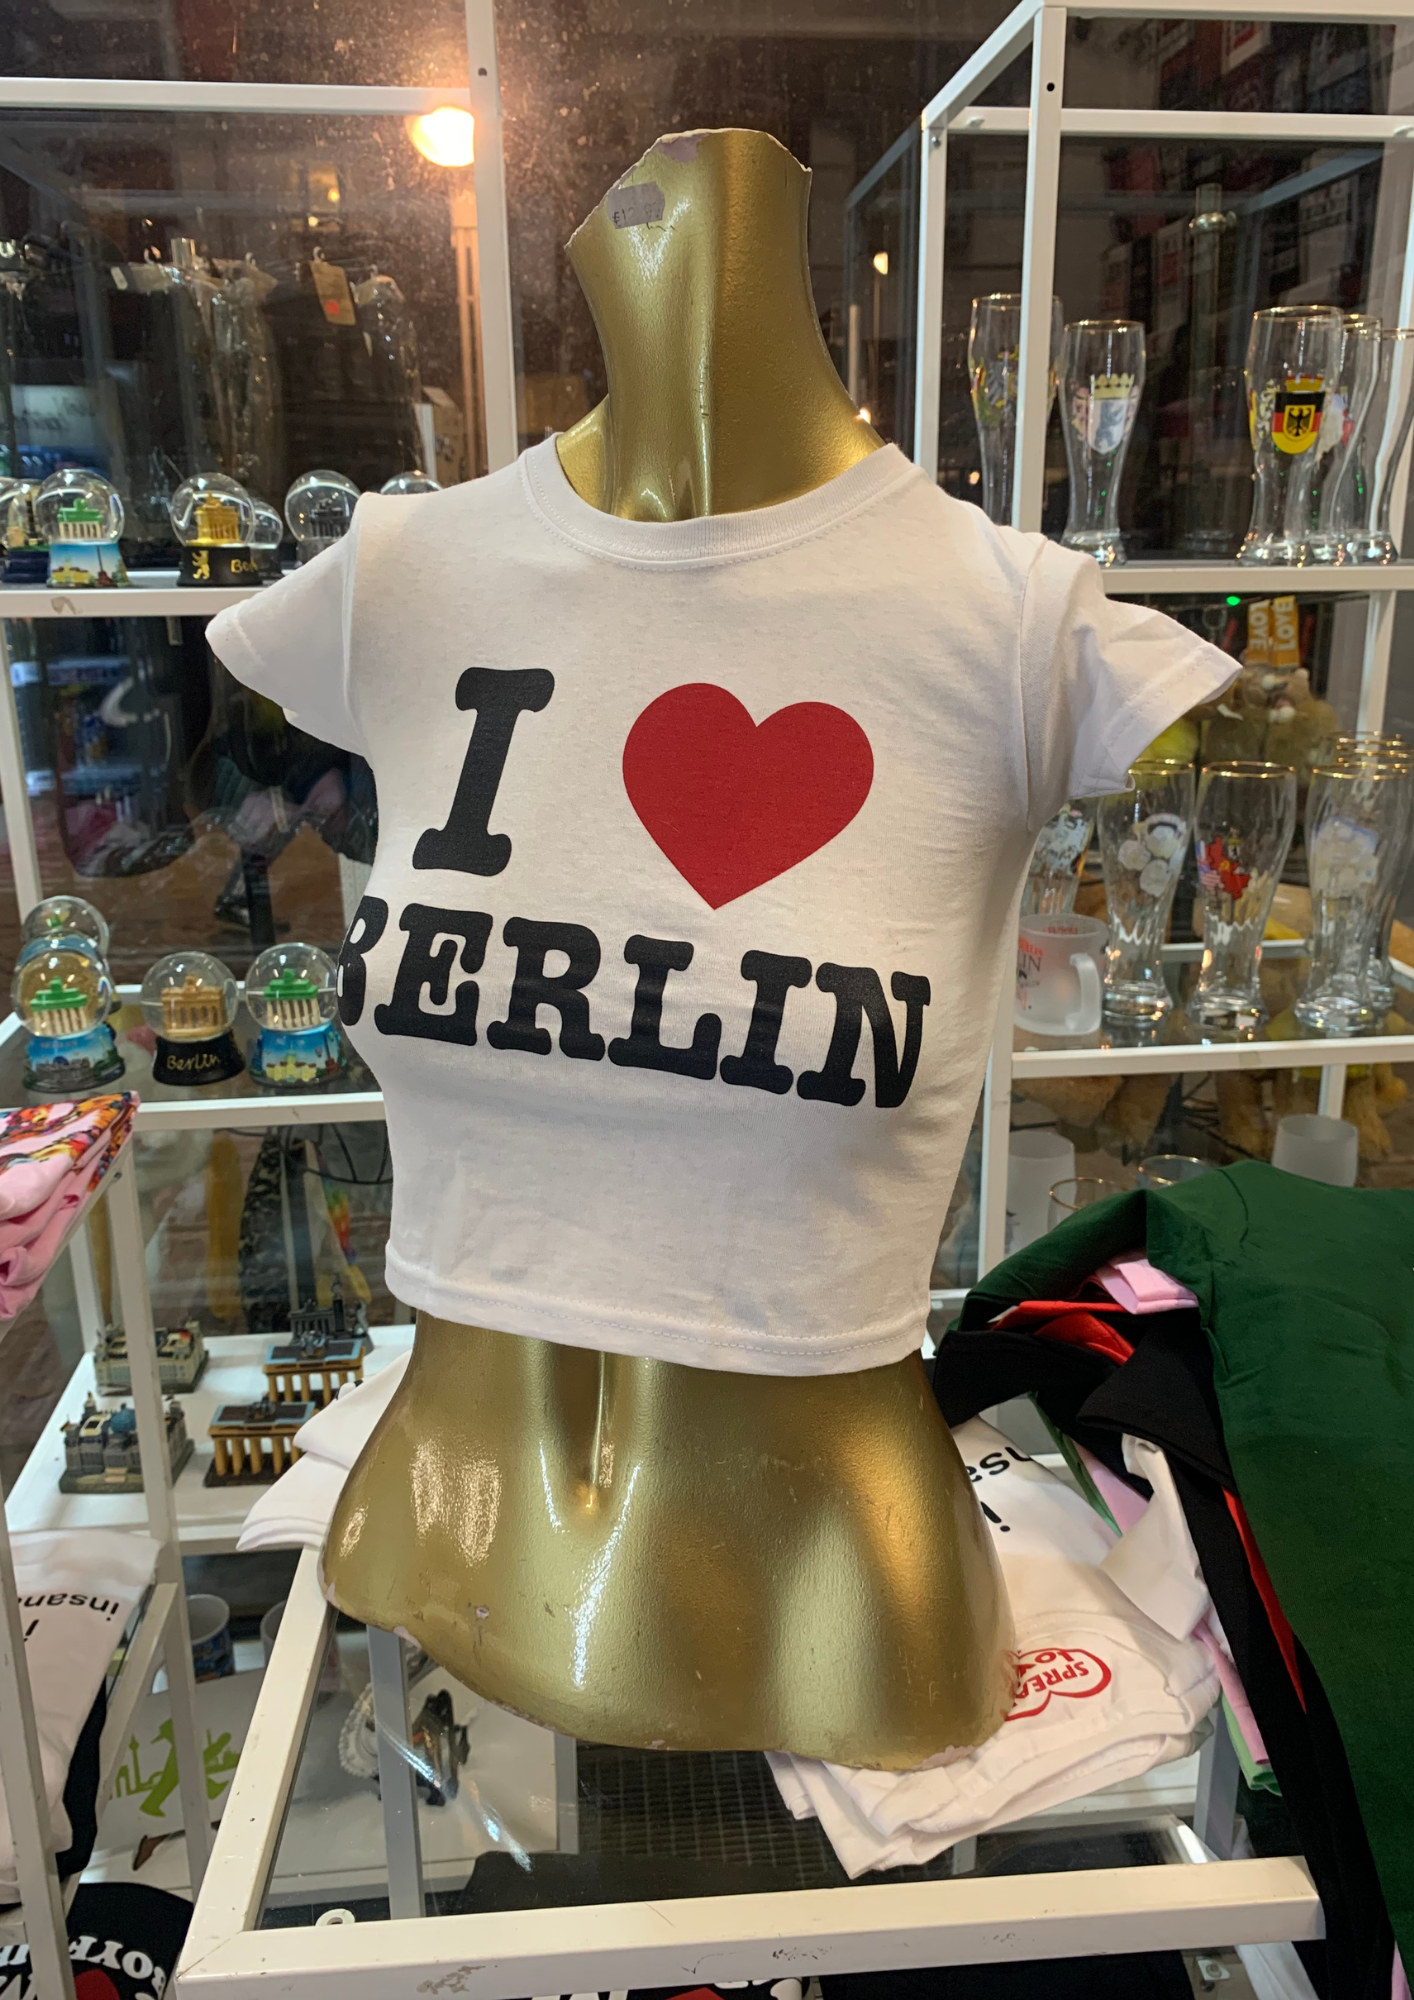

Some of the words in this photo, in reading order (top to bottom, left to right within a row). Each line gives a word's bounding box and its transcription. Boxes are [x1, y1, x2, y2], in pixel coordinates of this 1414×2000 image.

[1274, 600, 1296, 651] LOVE
[412, 667, 555, 876] I
[336, 895, 931, 1108] BERLIN
[166, 1053, 221, 1070] Berlin
[18, 1593, 119, 1621] insan
[1013, 1661, 1089, 1707] SPREA
